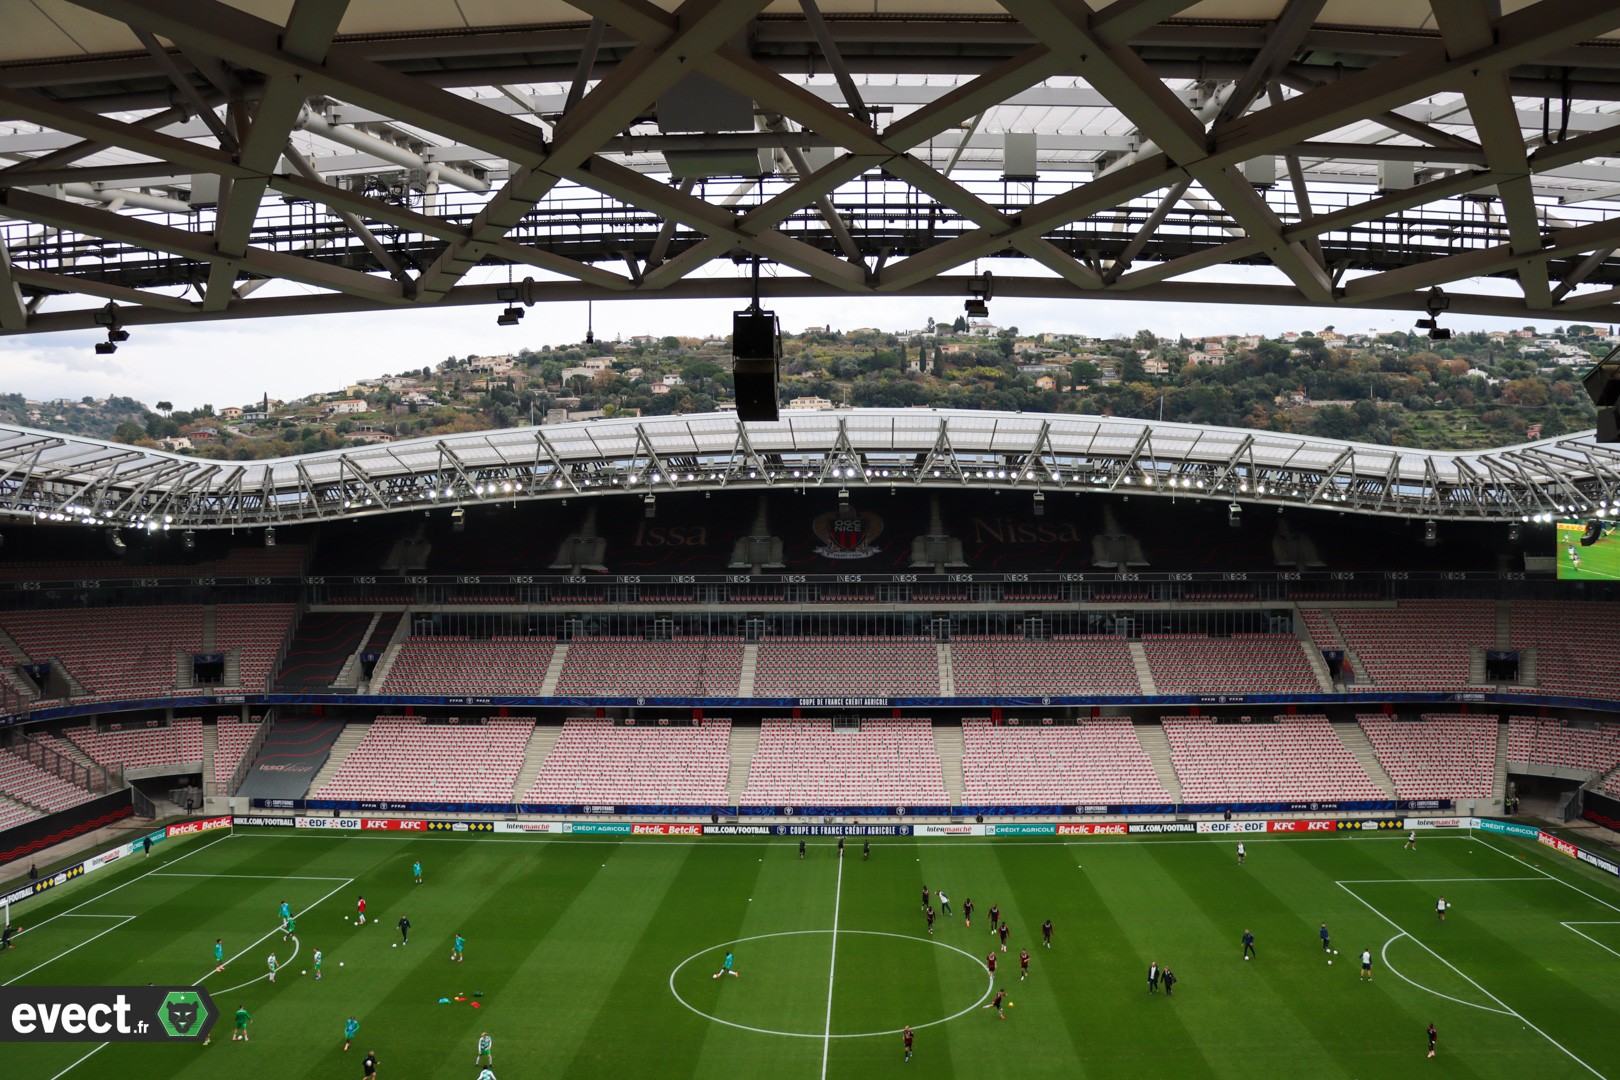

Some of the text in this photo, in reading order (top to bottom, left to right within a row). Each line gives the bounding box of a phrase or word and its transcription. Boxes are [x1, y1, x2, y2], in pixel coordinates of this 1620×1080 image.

[634, 521, 708, 547] Issa
[973, 517, 1082, 544] Nissa
[302, 576, 325, 584] INEOS
[353, 576, 376, 584] INEOS
[405, 576, 428, 584] INEOS
[457, 576, 480, 584] INEOS
[509, 576, 533, 584] INEOS
[562, 576, 586, 584] INEOS
[617, 576, 640, 584] INEOS
[671, 576, 695, 584] INEOS
[726, 576, 750, 584] INEOS
[781, 575, 805, 583] INEOS
[837, 574, 861, 582] INEOS
[892, 574, 917, 582] INEOS
[948, 574, 973, 582] INEOS
[1004, 574, 1028, 582] INEOS
[1059, 574, 1084, 582] INEOS
[1114, 573, 1139, 581] INEOS
[1168, 573, 1192, 581] INEOS
[1223, 572, 1247, 580] INEOS
[1277, 572, 1300, 580] INEOS
[1331, 572, 1354, 580] INEOS
[1385, 572, 1409, 580] INEOS
[1441, 572, 1465, 580] INEOS
[1499, 572, 1525, 580] INEOS
[74, 580, 100, 588] INEOS
[133, 579, 159, 587] INEOS
[191, 578, 216, 586] INEOS
[247, 577, 272, 585] INEOS
[15, 582, 41, 590] INEOS
[799, 698, 815, 706] COUPE
[825, 698, 843, 706] FRANCE
[845, 697, 863, 706] CRÉDIT
[864, 698, 888, 706] AGRICOLE
[233, 817, 294, 826] NIKE.COM/FOOTBALL
[367, 820, 421, 829] KFC KFC
[1273, 821, 1329, 830] KFC KFC
[169, 818, 231, 835] Betclic Betclic
[573, 823, 596, 832] CRÉDIT
[634, 825, 699, 834] Betclic Betclic
[704, 826, 770, 834] NIKE.COM/FOOTBALL
[790, 825, 896, 835] COUPE DE FRANCE CRÉDIT AGRICOLE
[1059, 825, 1124, 834] Betclic Betclic
[1129, 824, 1195, 832] NIKE.COM/FOOTBALL
[1481, 821, 1538, 836] CRÉDIT AGRICOLE
[1539, 833, 1575, 855] Betclic Betclic
